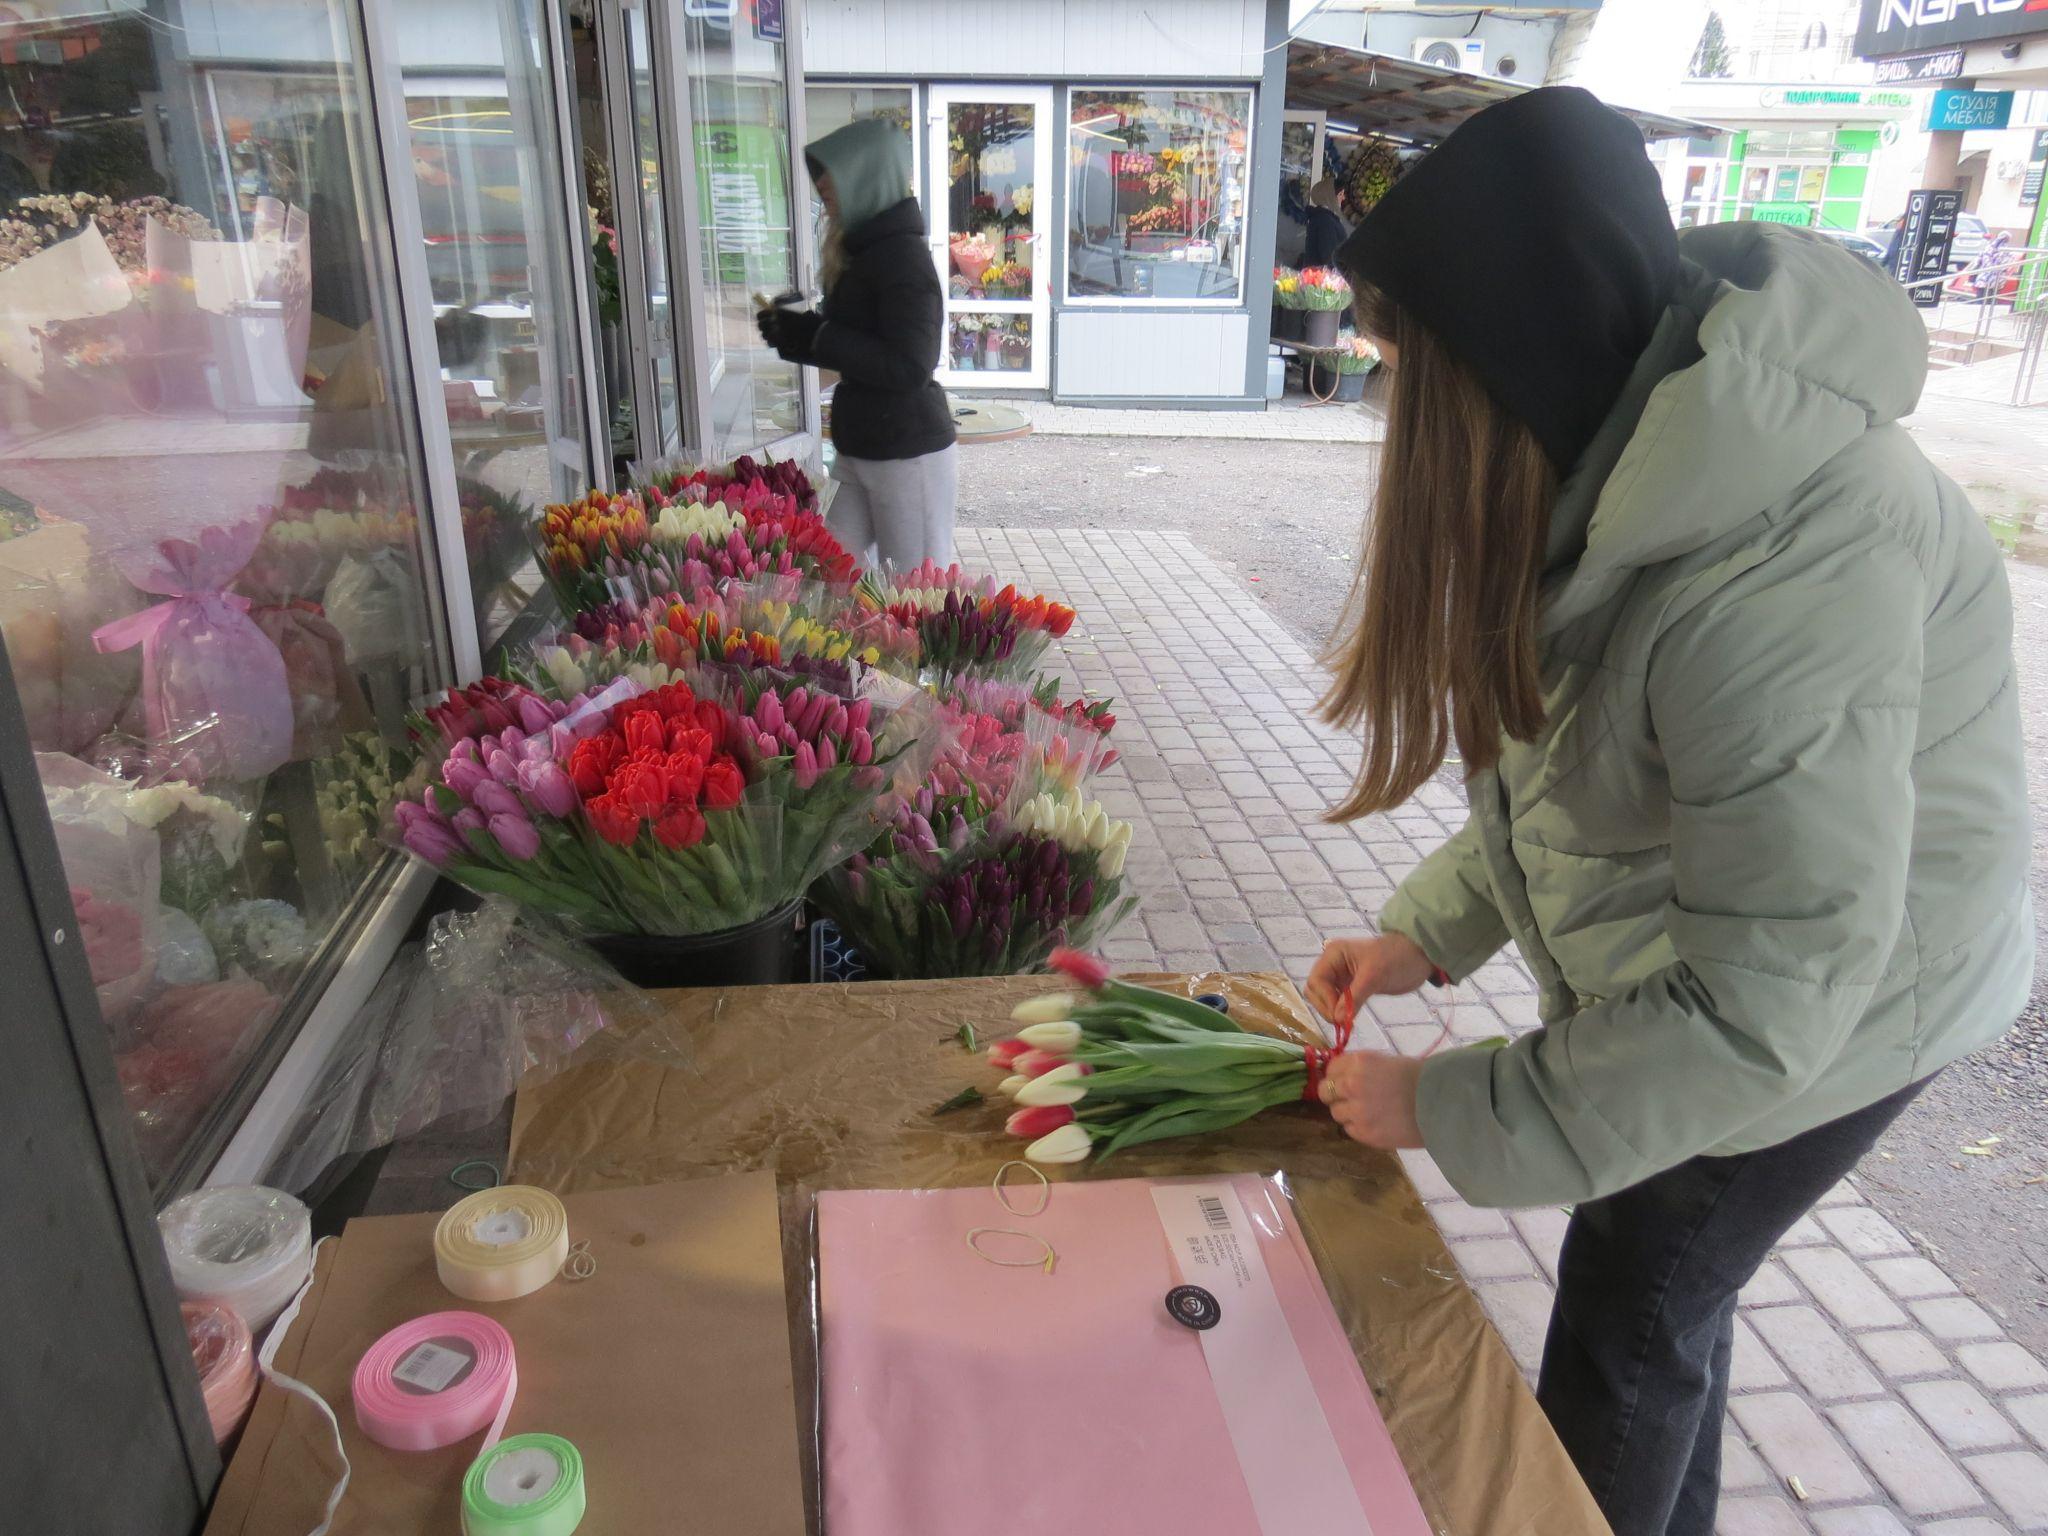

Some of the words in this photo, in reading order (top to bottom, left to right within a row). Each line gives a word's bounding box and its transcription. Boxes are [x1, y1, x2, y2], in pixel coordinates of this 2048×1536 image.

[1947, 96, 1998, 110] СТУДІЯ
[1943, 110, 1995, 126] МЕБЛІВ
[1758, 211, 1802, 226] АПТЕКА
[1898, 198, 1922, 282] OUTLE
